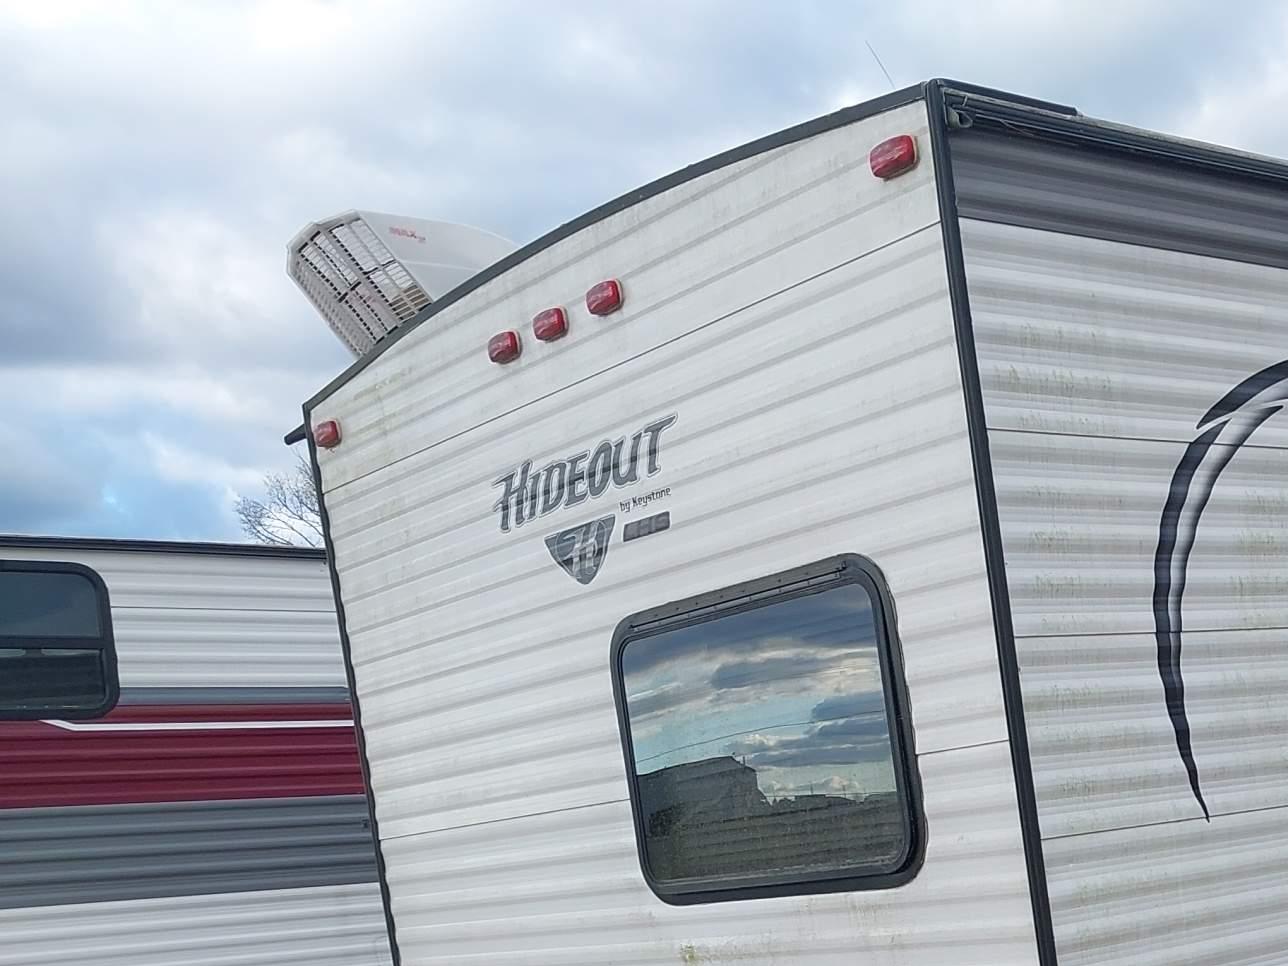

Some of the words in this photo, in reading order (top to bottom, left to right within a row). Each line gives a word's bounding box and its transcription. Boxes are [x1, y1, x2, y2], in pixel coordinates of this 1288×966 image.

[491, 411, 678, 534] HIDEOUT
[619, 501, 631, 513] by
[632, 487, 671, 507] Keystone
